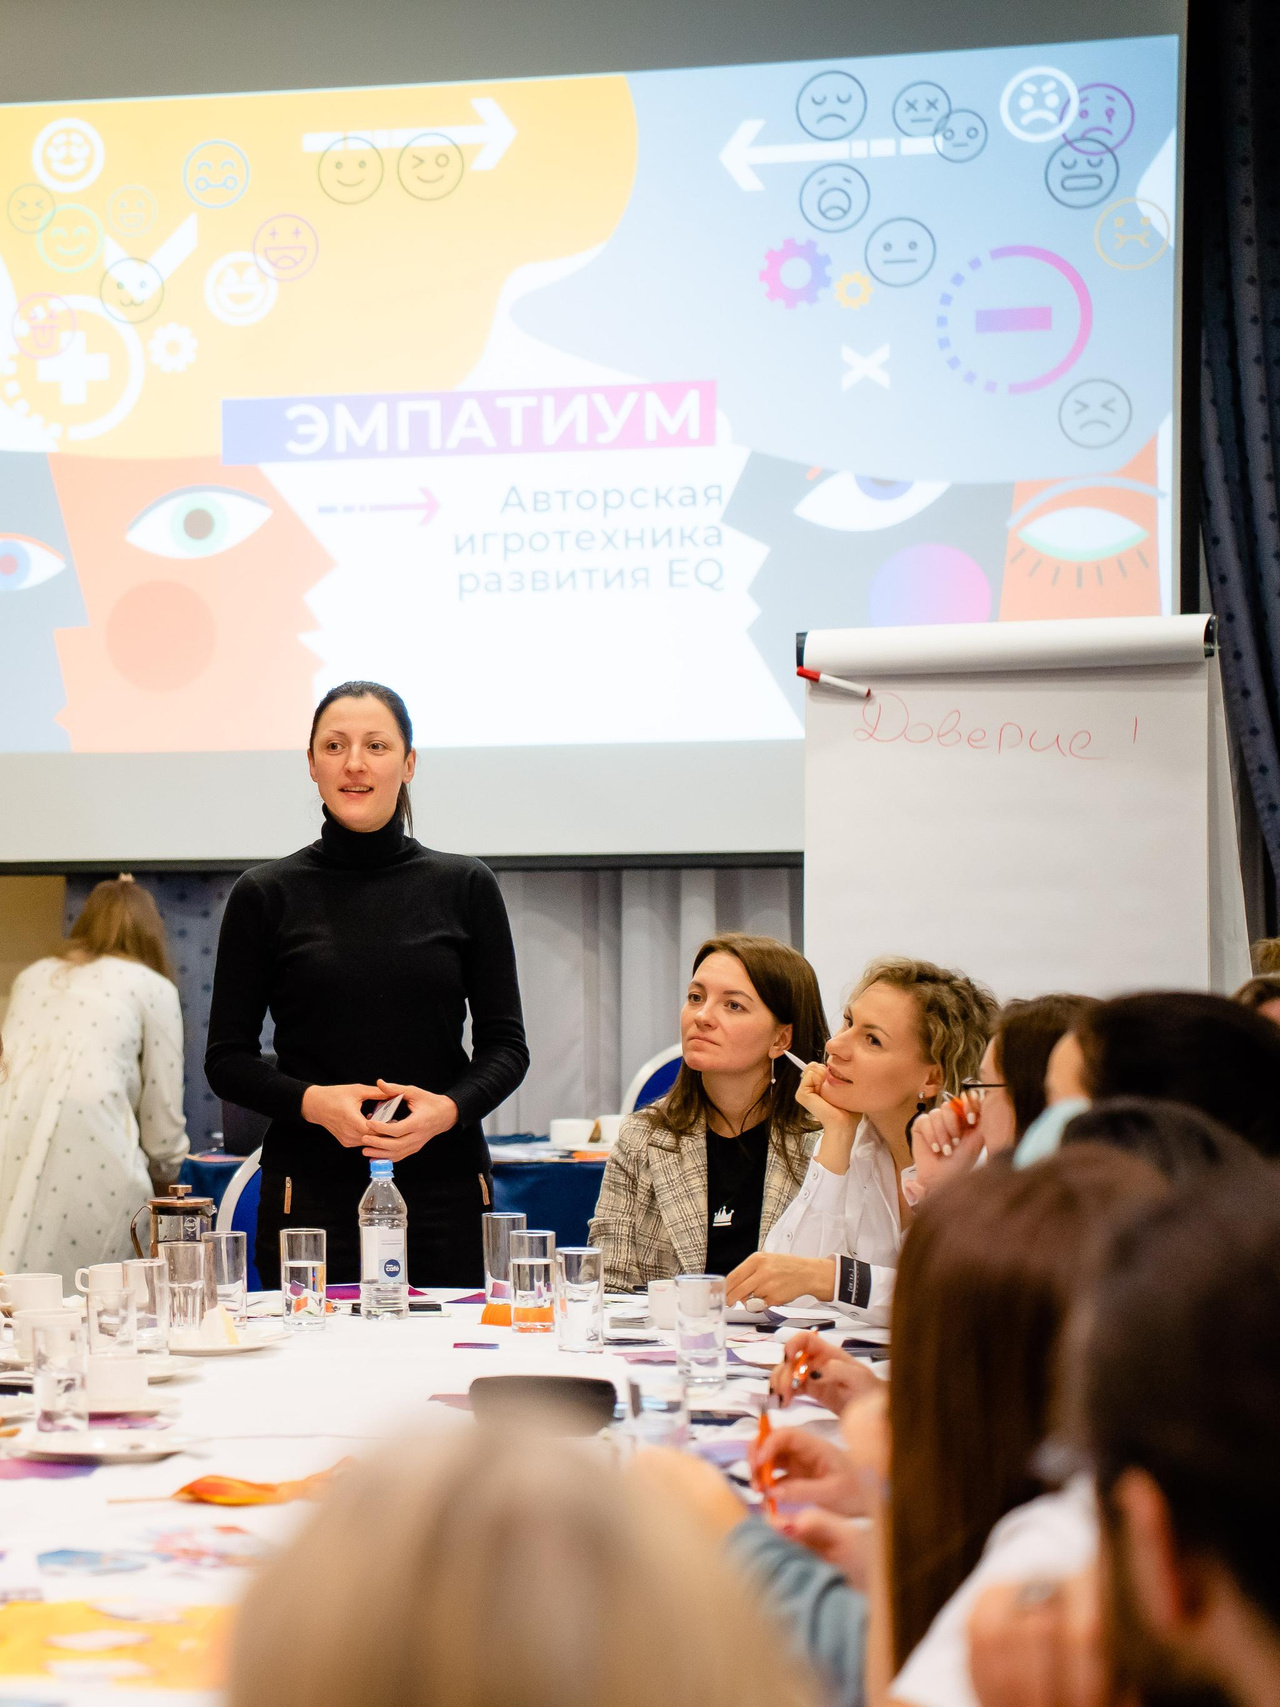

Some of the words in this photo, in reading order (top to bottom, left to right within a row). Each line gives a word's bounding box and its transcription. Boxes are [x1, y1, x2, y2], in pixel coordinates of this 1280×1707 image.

[285, 388, 701, 456] ЭМПАТИУМ
[500, 482, 723, 519] Авторская
[453, 523, 723, 562] игротехника
[457, 565, 650, 601] развития
[667, 557, 726, 592] EQ
[853, 692, 1109, 760] Доверие
